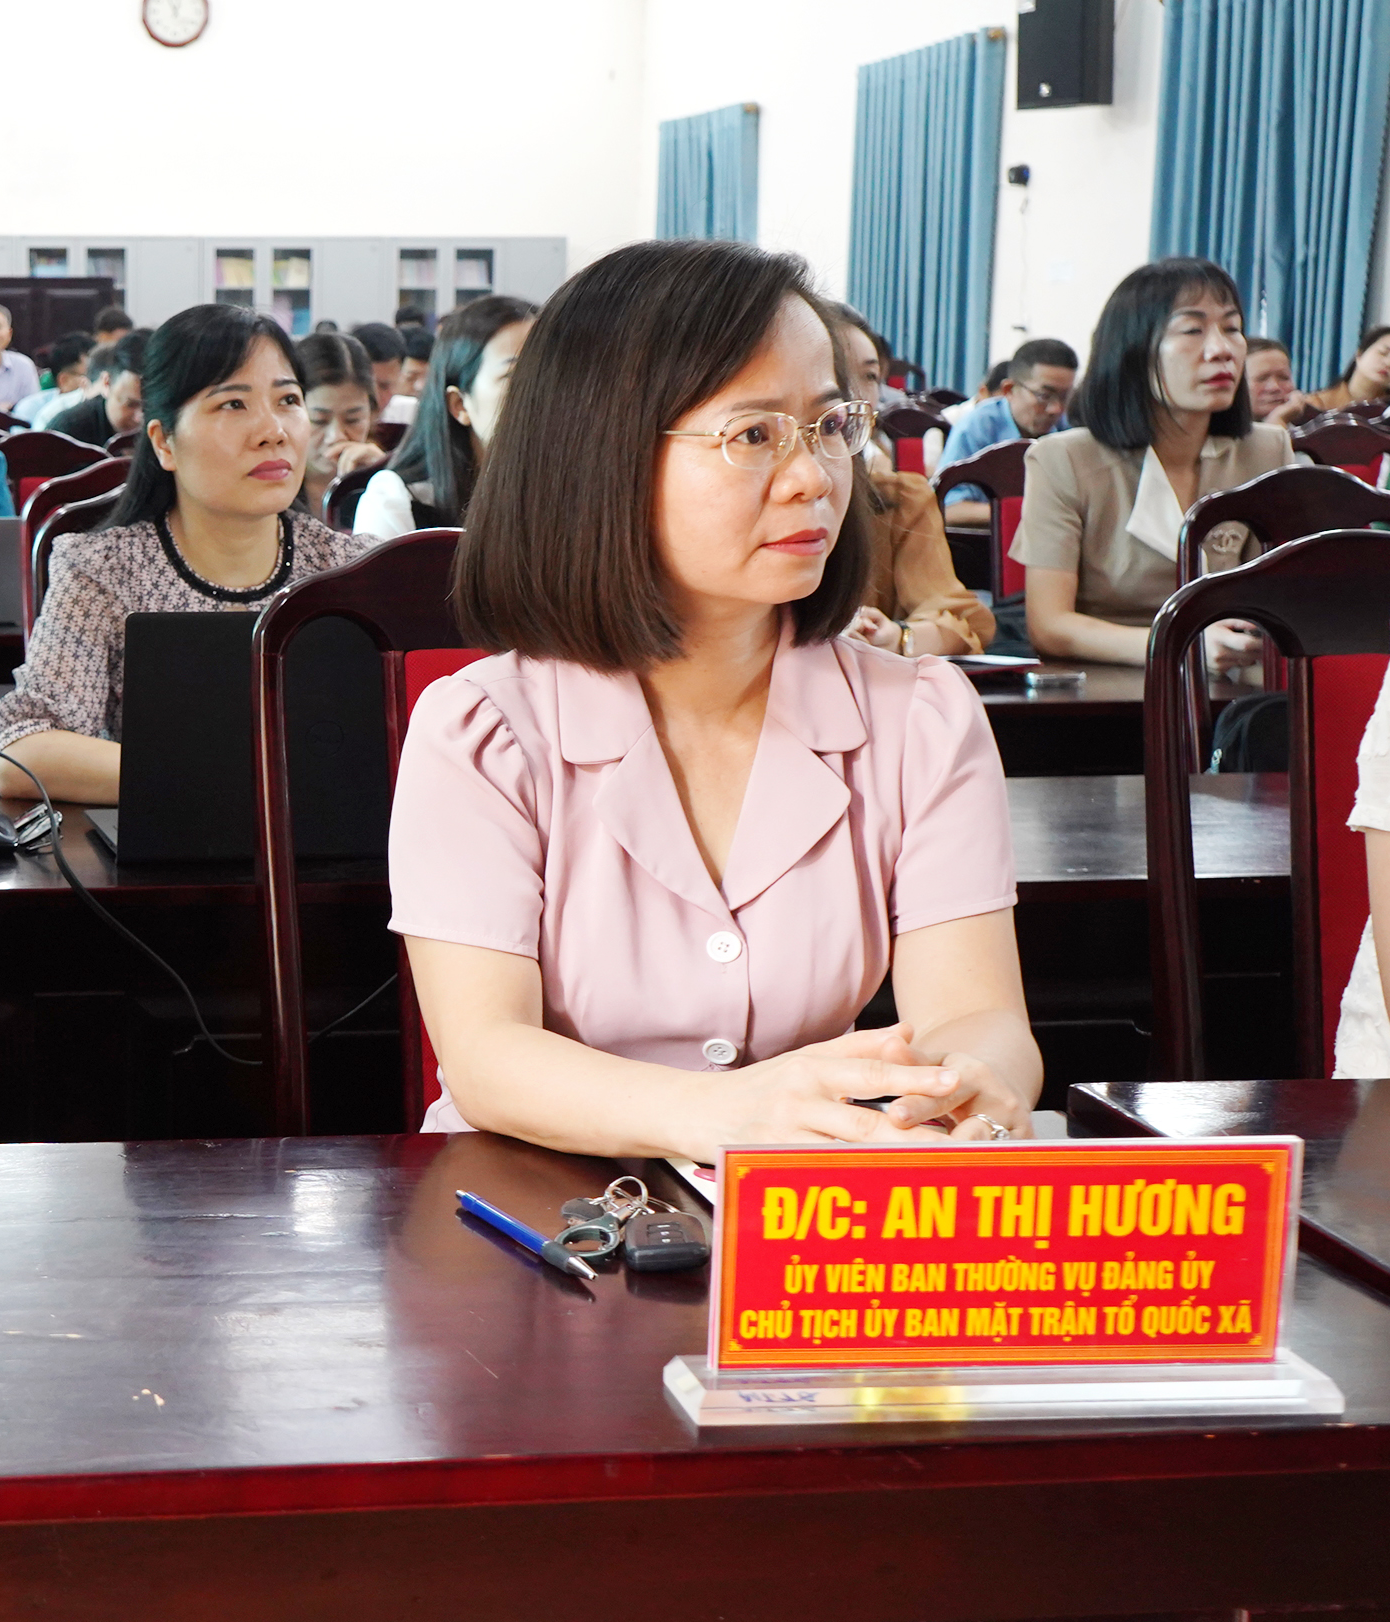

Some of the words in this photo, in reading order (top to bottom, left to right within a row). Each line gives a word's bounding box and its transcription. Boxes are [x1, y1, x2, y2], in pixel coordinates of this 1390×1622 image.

[761, 1185, 868, 1241] Đ/C:
[881, 1186, 959, 1239] AN
[972, 1185, 1054, 1249] THỊ
[1067, 1179, 1247, 1238] HƯƠNG
[784, 1254, 820, 1294] ỦY
[825, 1257, 886, 1293] VIÊN
[891, 1263, 947, 1293] BAN
[952, 1255, 1056, 1292] THƯỜNG
[1062, 1261, 1098, 1297] VỤ
[1101, 1251, 1174, 1290] ĐẢNG
[1180, 1250, 1216, 1290] ỦY
[739, 1299, 794, 1340] CHỦ
[799, 1308, 858, 1345] TỊCH
[863, 1299, 900, 1338] ỦY
[904, 1307, 960, 1337] BAN
[965, 1301, 1024, 1343] MẶT
[1028, 1301, 1098, 1342] TRẬN
[1103, 1294, 1136, 1335] TỔ
[1141, 1295, 1212, 1338] QUỐC
[1216, 1299, 1253, 1334] XÃ
